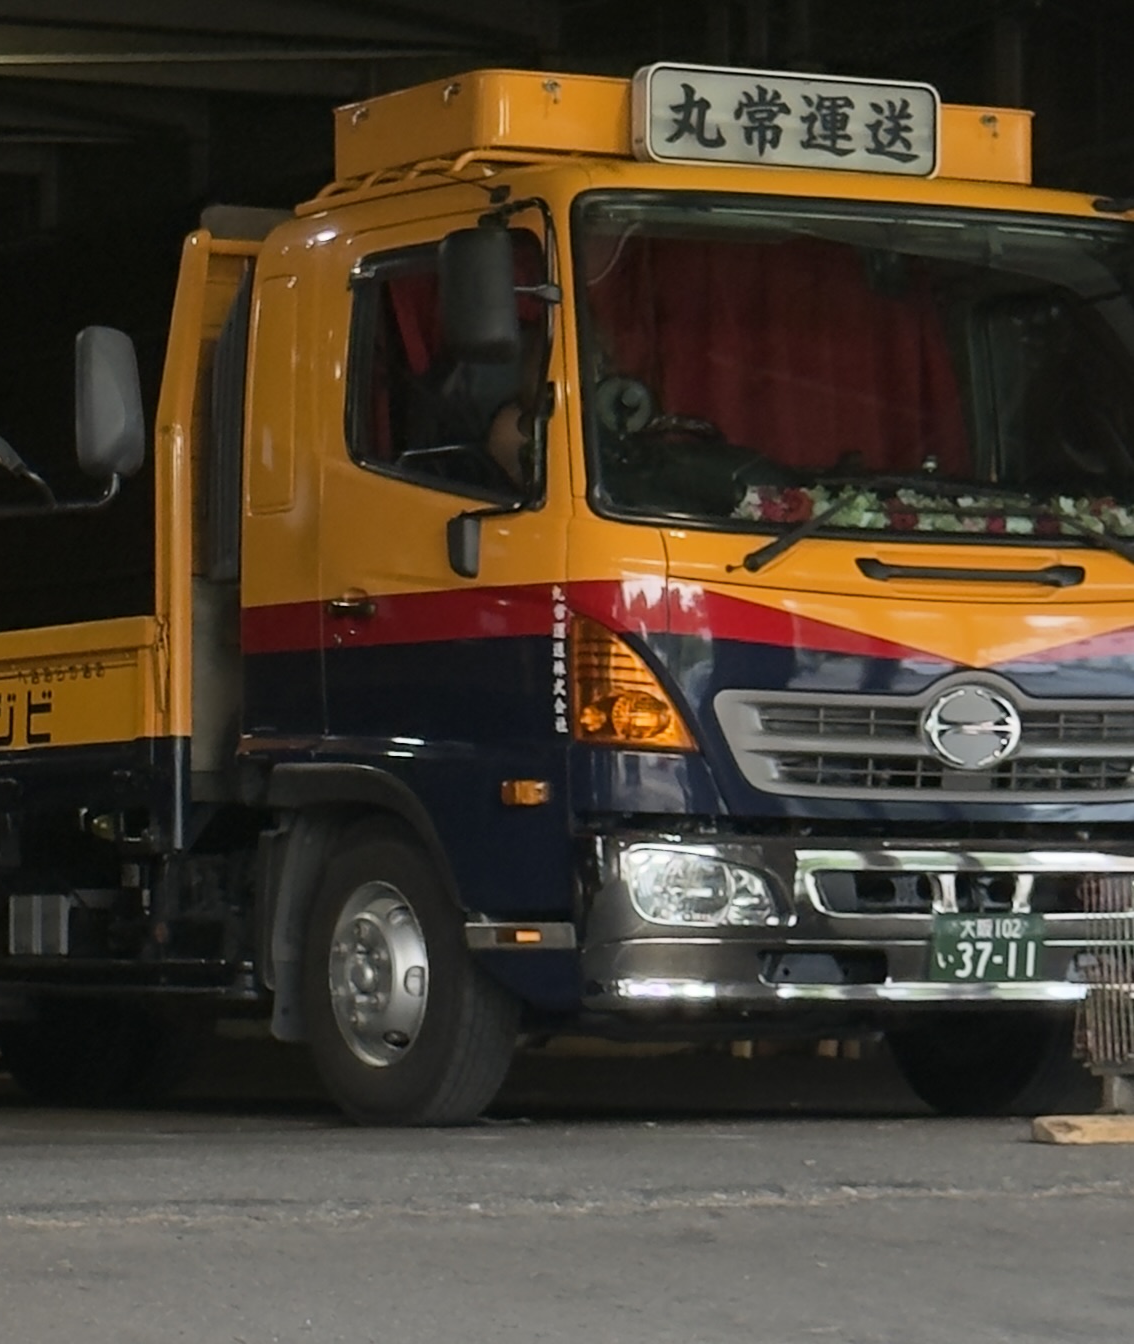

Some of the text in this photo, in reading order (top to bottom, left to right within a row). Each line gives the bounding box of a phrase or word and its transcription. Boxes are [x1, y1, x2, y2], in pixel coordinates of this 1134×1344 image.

[665, 83, 920, 163] 丸常運送
[955, 941, 1036, 978] 37-11
